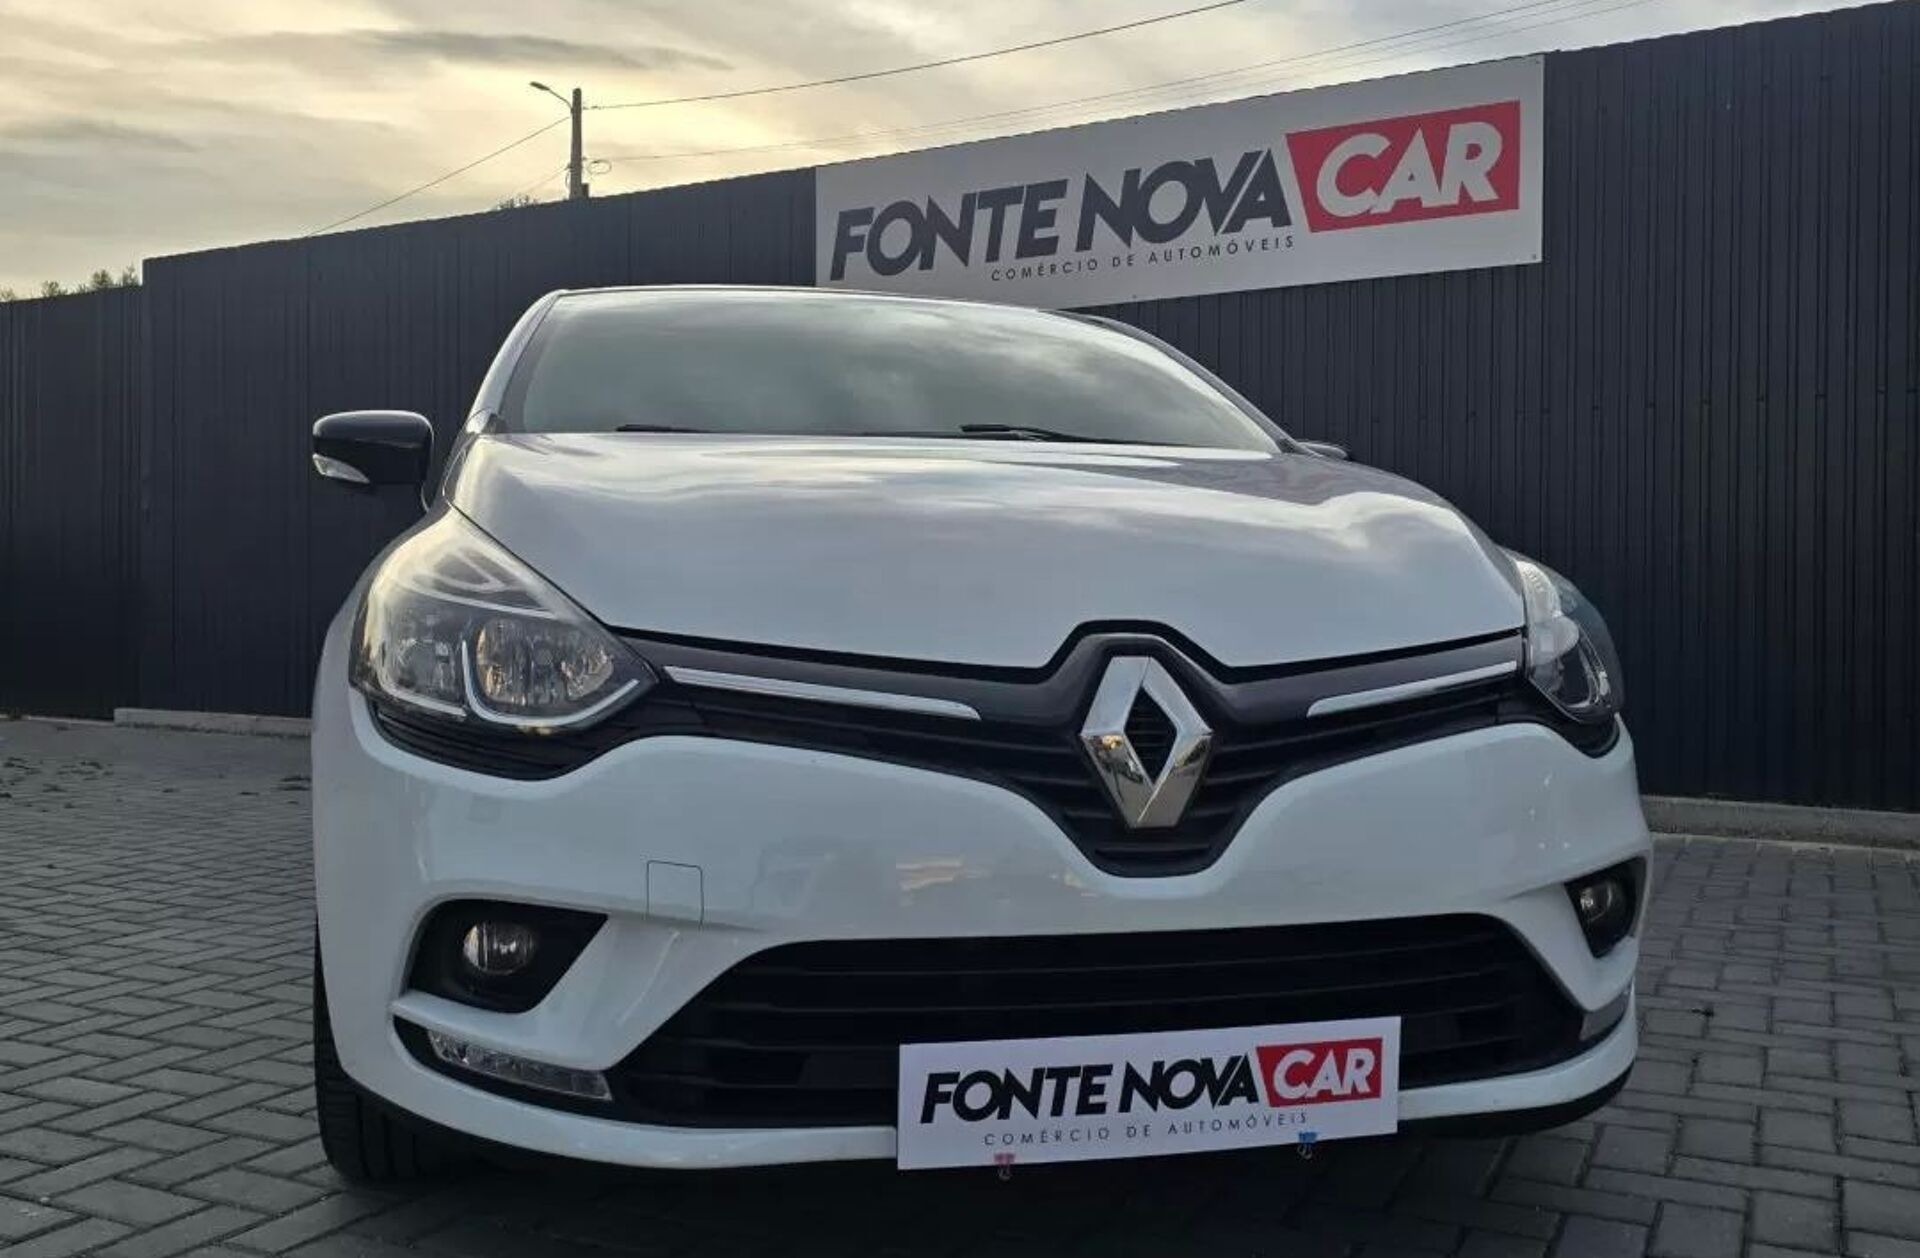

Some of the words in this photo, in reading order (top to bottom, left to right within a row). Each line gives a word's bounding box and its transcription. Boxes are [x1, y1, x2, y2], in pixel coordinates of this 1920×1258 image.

[829, 179, 1069, 281] FONTE
[1075, 148, 1293, 252] NOVA
[1315, 121, 1504, 218] CAR
[990, 257, 1099, 282] COMÉRCIO
[1111, 254, 1137, 268] DE
[1148, 235, 1295, 265] AUTOMÓVEIS
[920, 1063, 1113, 1124] FONTE
[1118, 1055, 1260, 1114] NOVA
[1272, 1047, 1376, 1100] CAR
[984, 1128, 1110, 1145] COMÉRCIO
[1126, 1125, 1152, 1139] DE
[1167, 1111, 1308, 1135] AUTOMÓVEIS
